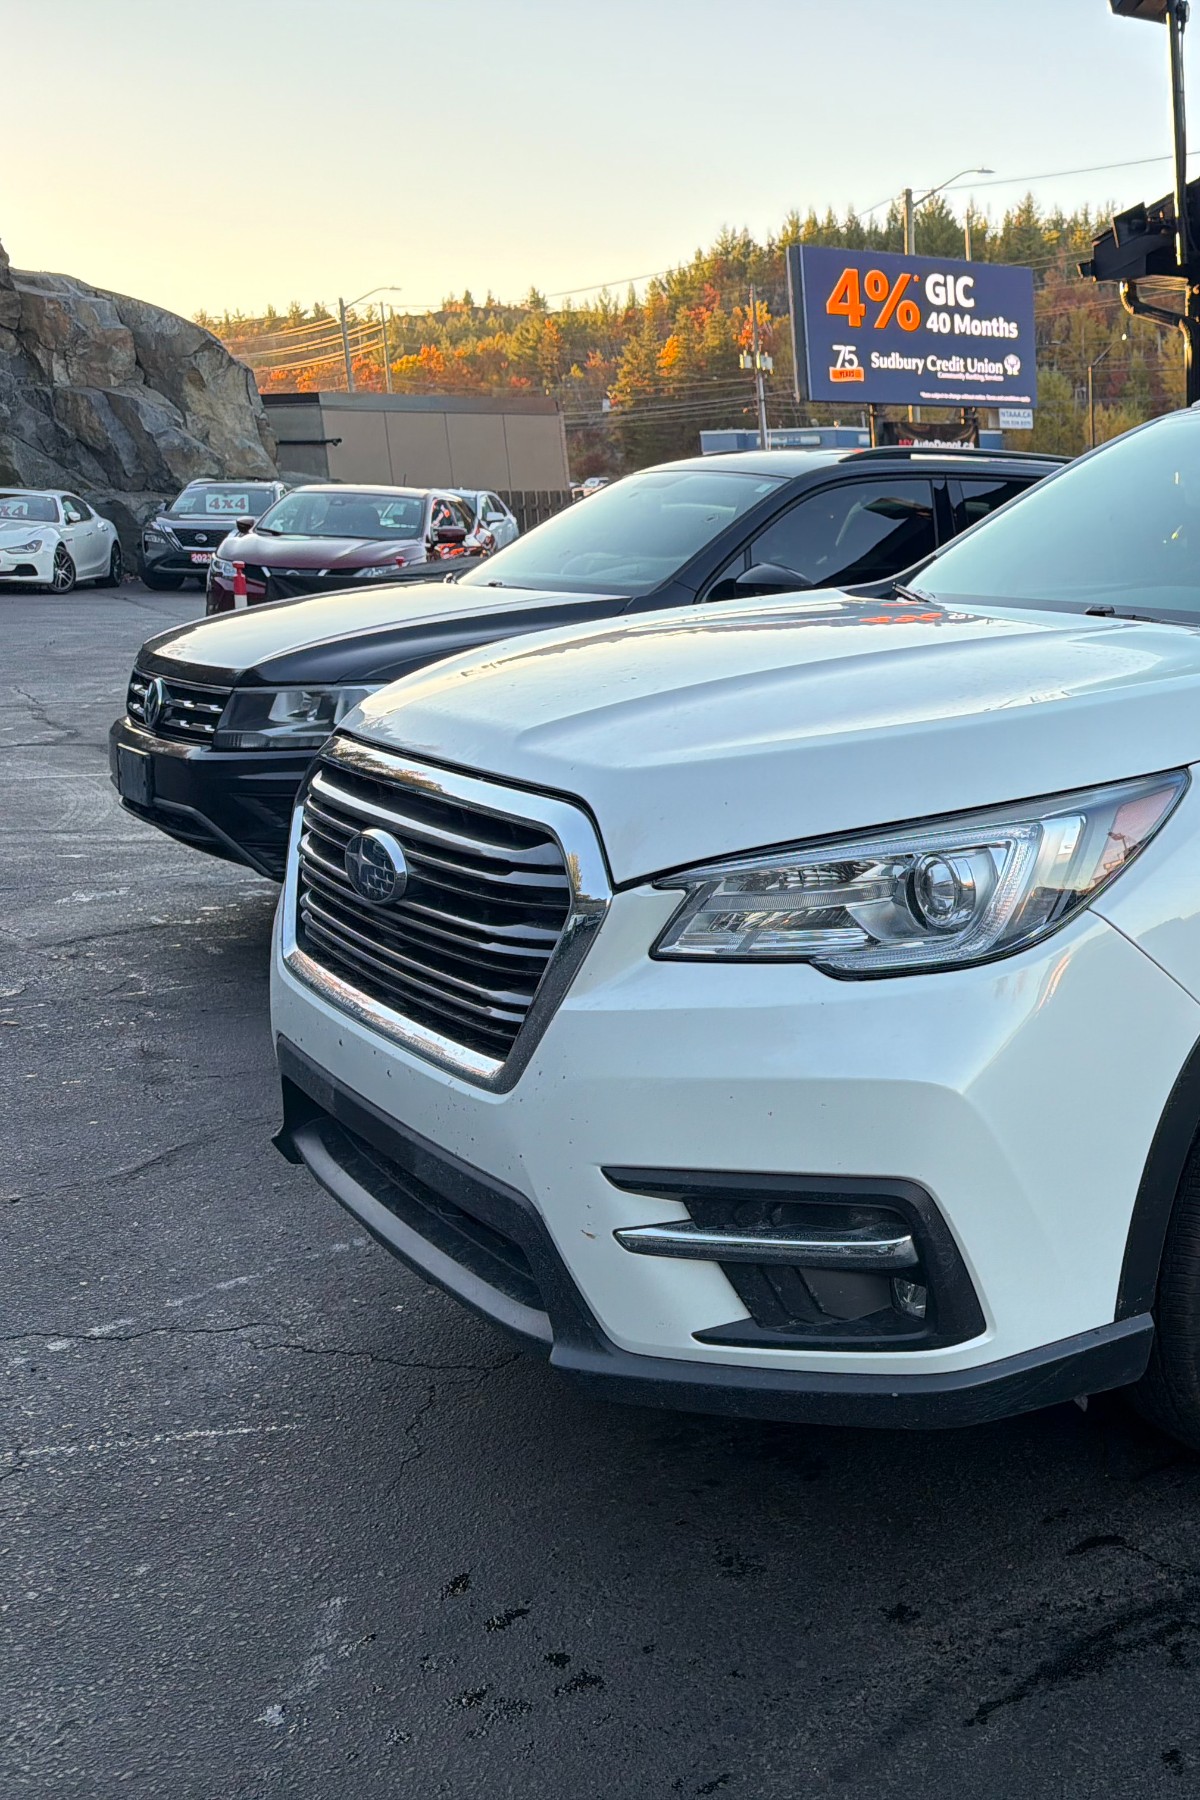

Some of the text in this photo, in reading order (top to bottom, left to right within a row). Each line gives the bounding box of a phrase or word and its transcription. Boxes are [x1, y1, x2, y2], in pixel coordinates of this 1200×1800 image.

[925, 273, 975, 308] GIC
[926, 312, 1019, 339] 40 Months
[832, 345, 859, 368] 75
[871, 352, 1004, 375] Sudbury Credit Union
[0, 505, 26, 517] x4
